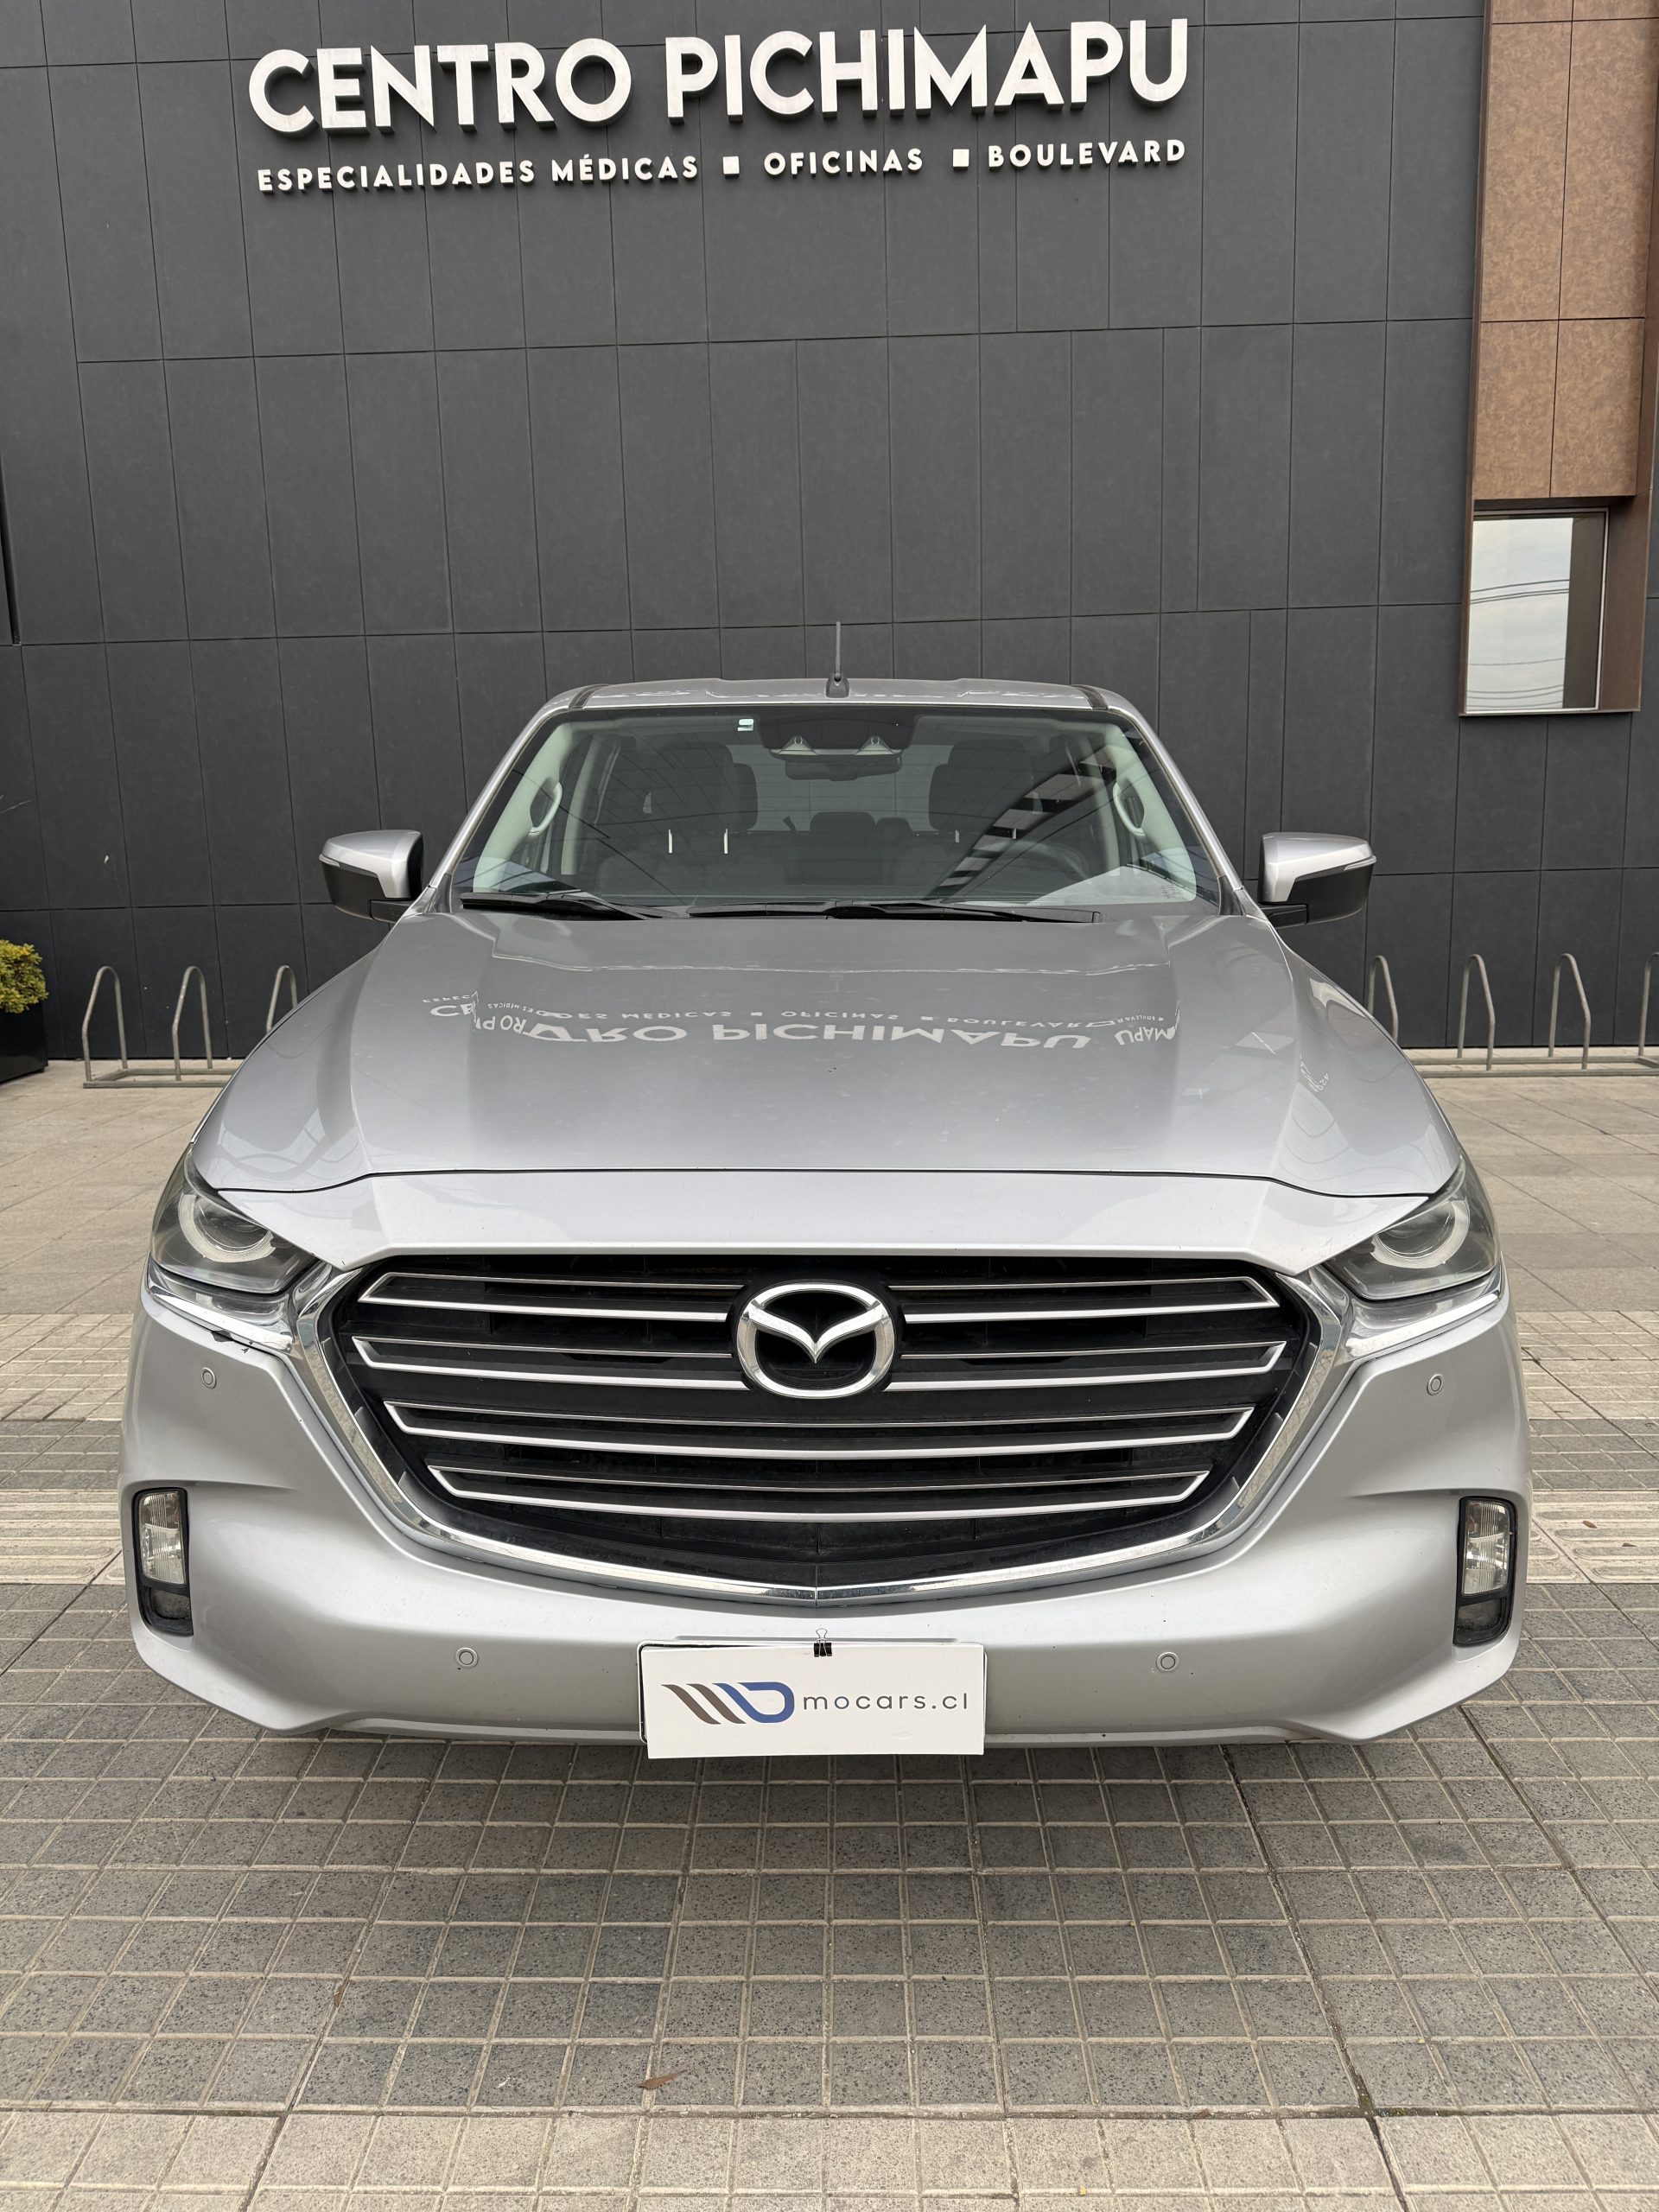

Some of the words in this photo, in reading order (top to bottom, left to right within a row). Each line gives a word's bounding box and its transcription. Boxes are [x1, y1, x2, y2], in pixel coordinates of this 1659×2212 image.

[248, 37, 632, 132] CENTRO
[664, 18, 1188, 118] PICHIMAPU
[257, 159, 535, 192] ESPECIALIDADES
[551, 153, 697, 181] MÉDICAS
[764, 148, 923, 175] OFICINAS
[988, 138, 1185, 168] BOULEVARD
[803, 1692, 968, 1711] mocars.cl
